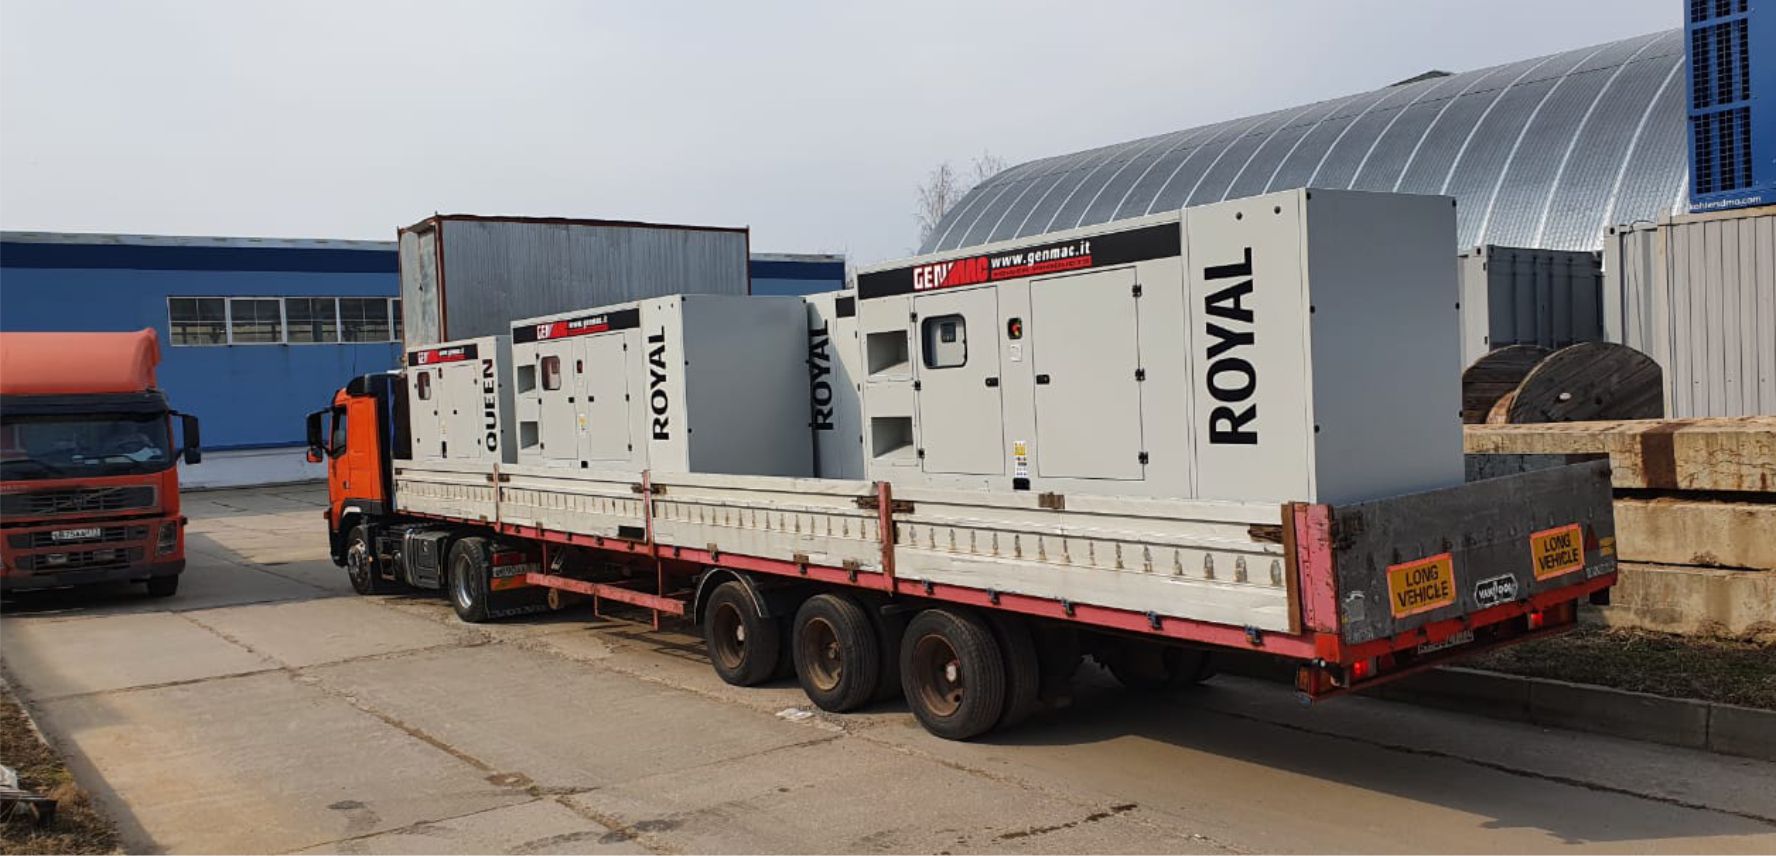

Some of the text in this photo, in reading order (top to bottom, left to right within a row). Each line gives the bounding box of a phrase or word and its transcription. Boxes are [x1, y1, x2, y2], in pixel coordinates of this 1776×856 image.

[991, 241, 1091, 268] www.genmac.it
[1203, 247, 1258, 445] ROYAL
[648, 325, 670, 441] ROYAL
[808, 319, 834, 431] ROYAL
[482, 358, 498, 452] QUEEN
[1544, 532, 1571, 553] LONG
[1538, 547, 1579, 571] VEHICLE
[1405, 564, 1439, 588] LONG
[1397, 580, 1449, 608] VEHICLE
